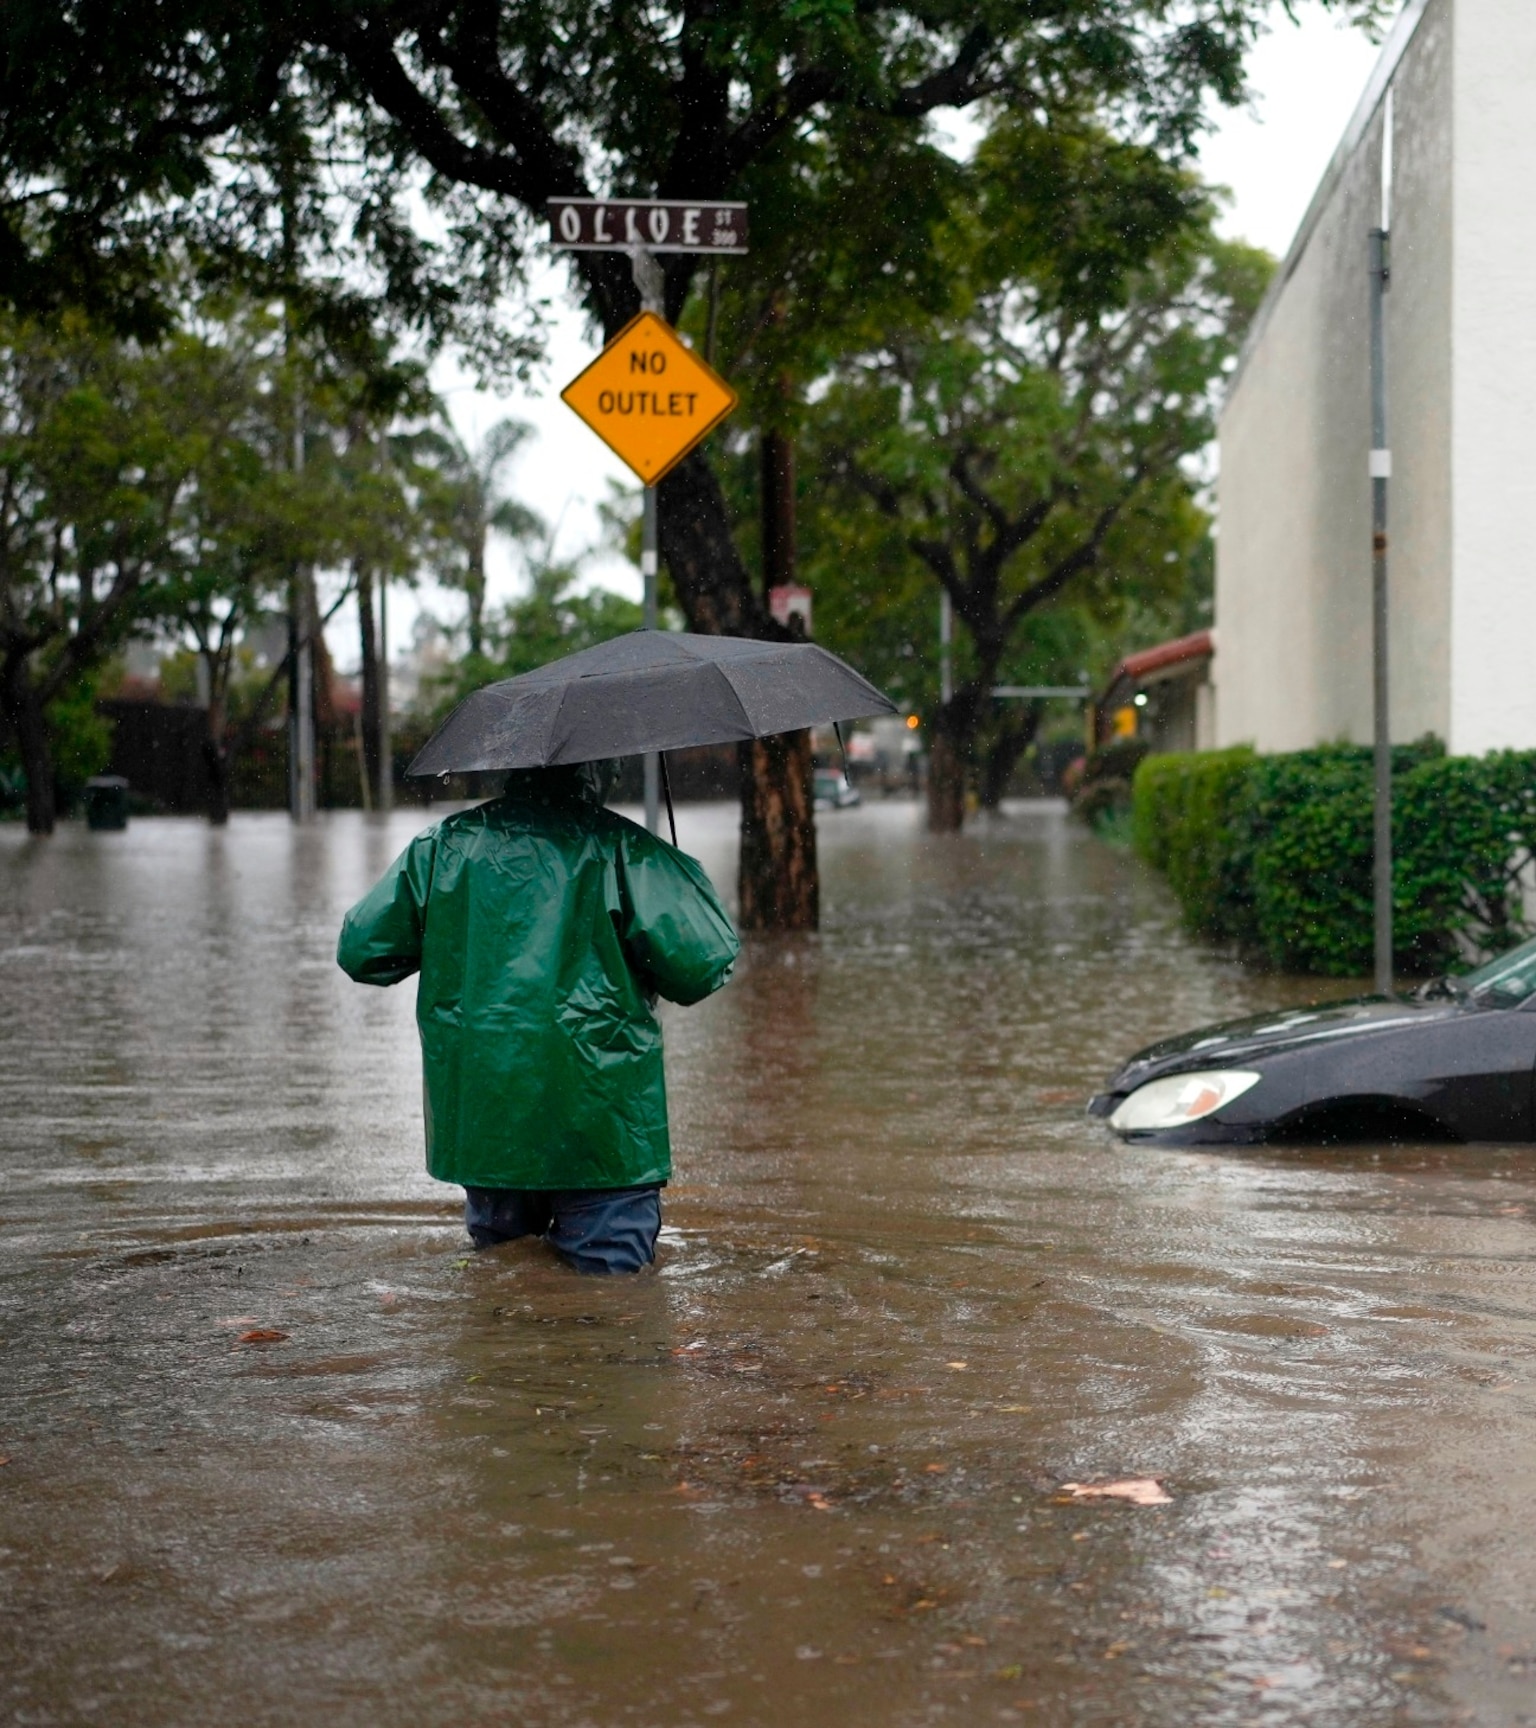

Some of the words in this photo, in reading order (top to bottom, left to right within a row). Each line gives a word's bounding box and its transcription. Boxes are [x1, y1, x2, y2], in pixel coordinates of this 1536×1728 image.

[559, 205, 702, 245] OLIVE
[630, 351, 667, 375] NO
[598, 390, 698, 416] OUTLET
